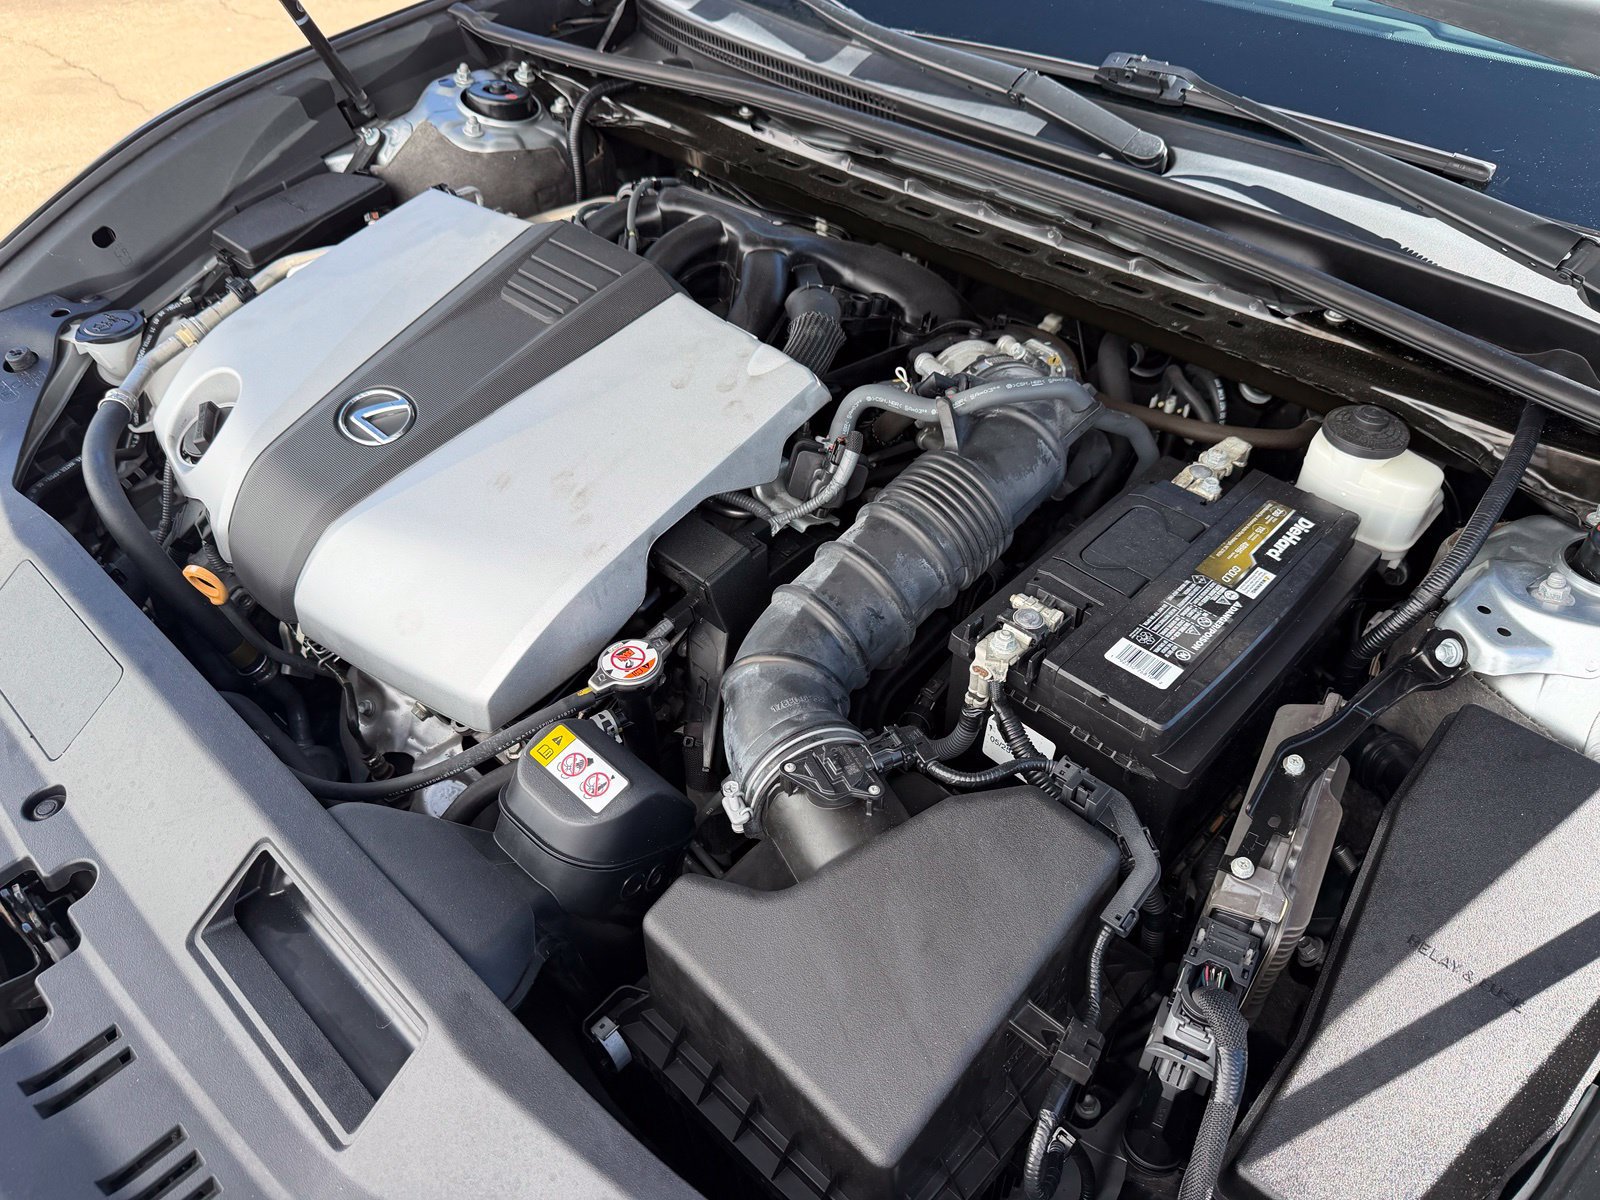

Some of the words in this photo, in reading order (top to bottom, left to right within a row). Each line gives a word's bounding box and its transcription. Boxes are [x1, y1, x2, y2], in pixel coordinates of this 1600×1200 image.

[1266, 517, 1315, 561] DieHard
[1221, 565, 1242, 583] GOLD
[1189, 603, 1239, 652] DANGER/POISON
[1407, 934, 1461, 972] RELAY
[1462, 970, 1473, 983] &
[1479, 978, 1524, 1014] FUSE
